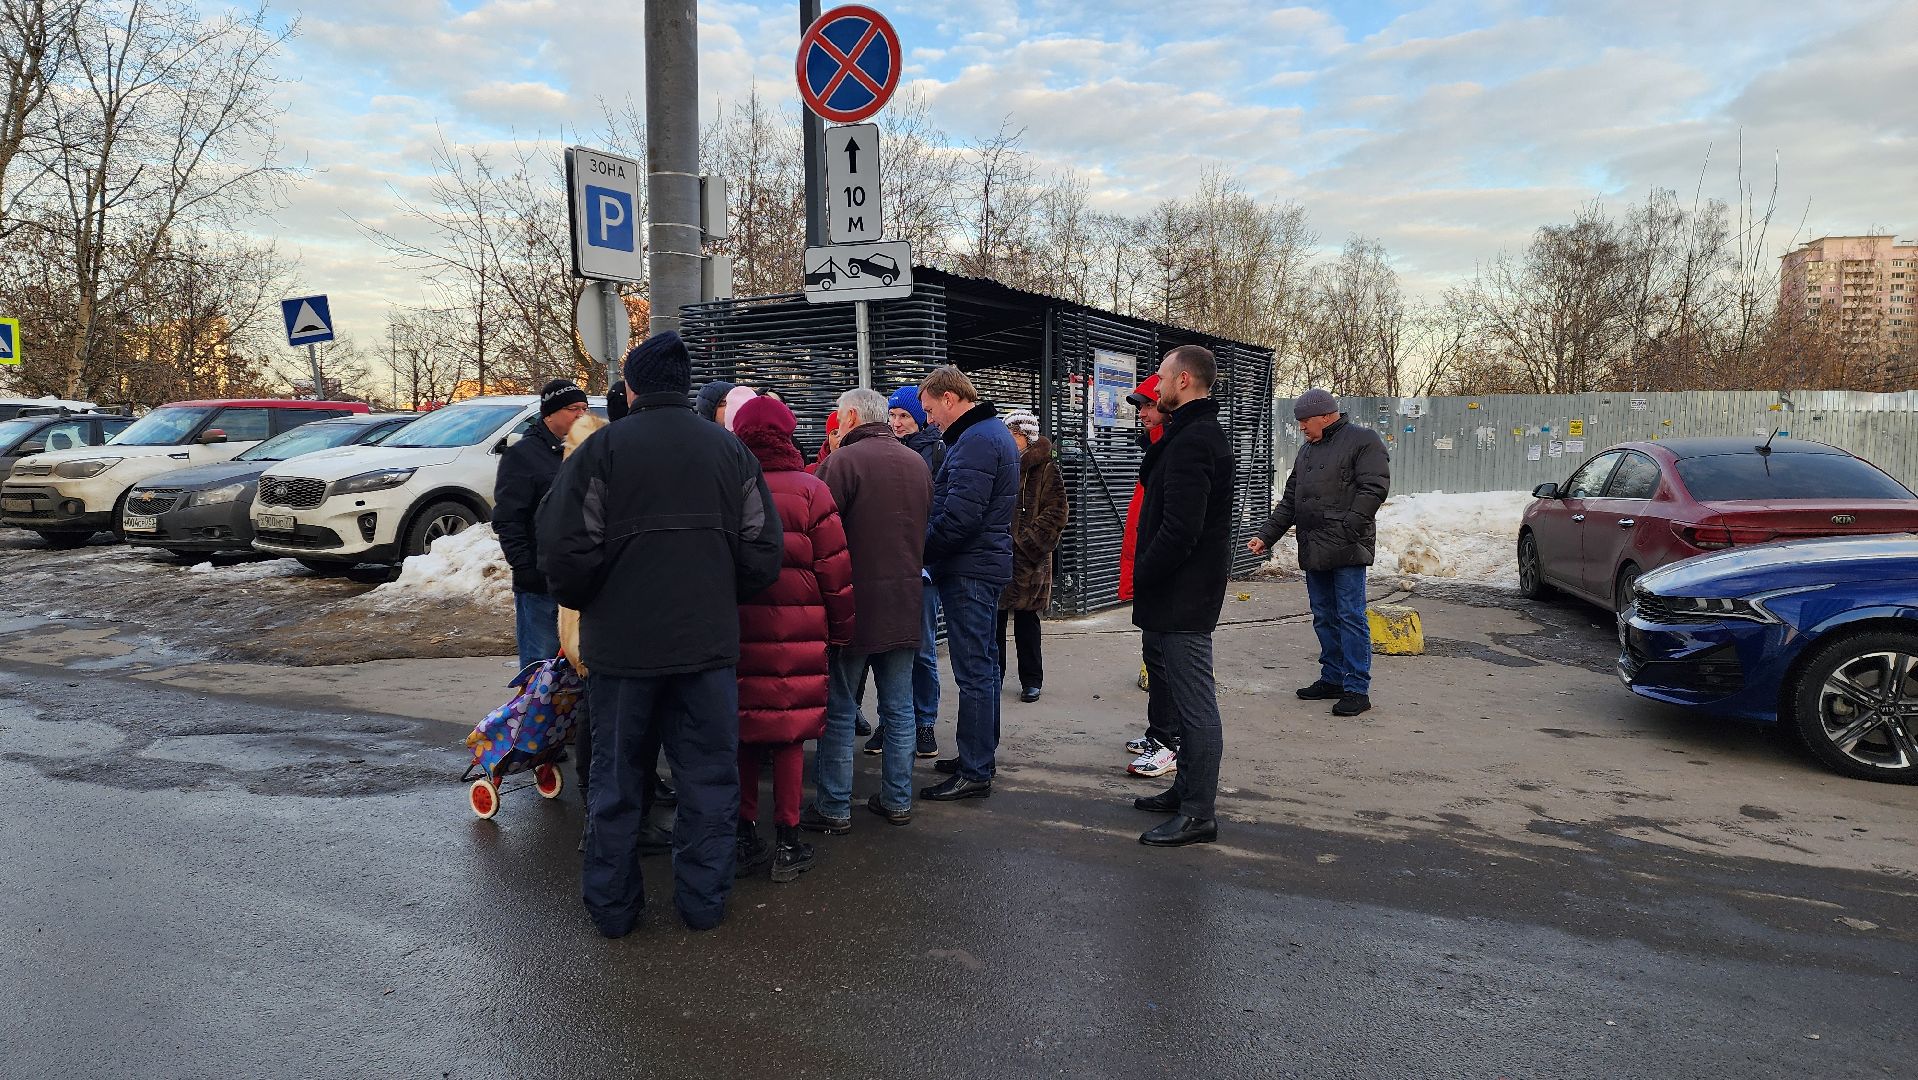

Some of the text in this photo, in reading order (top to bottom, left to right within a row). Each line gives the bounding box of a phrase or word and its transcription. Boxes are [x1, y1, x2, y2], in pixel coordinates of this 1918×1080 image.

[590, 159, 626, 179] ЗОНА
[843, 186, 866, 208] 10
[599, 194, 625, 241] P
[847, 216, 865, 233] М
[1834, 516, 1853, 524] KIA
